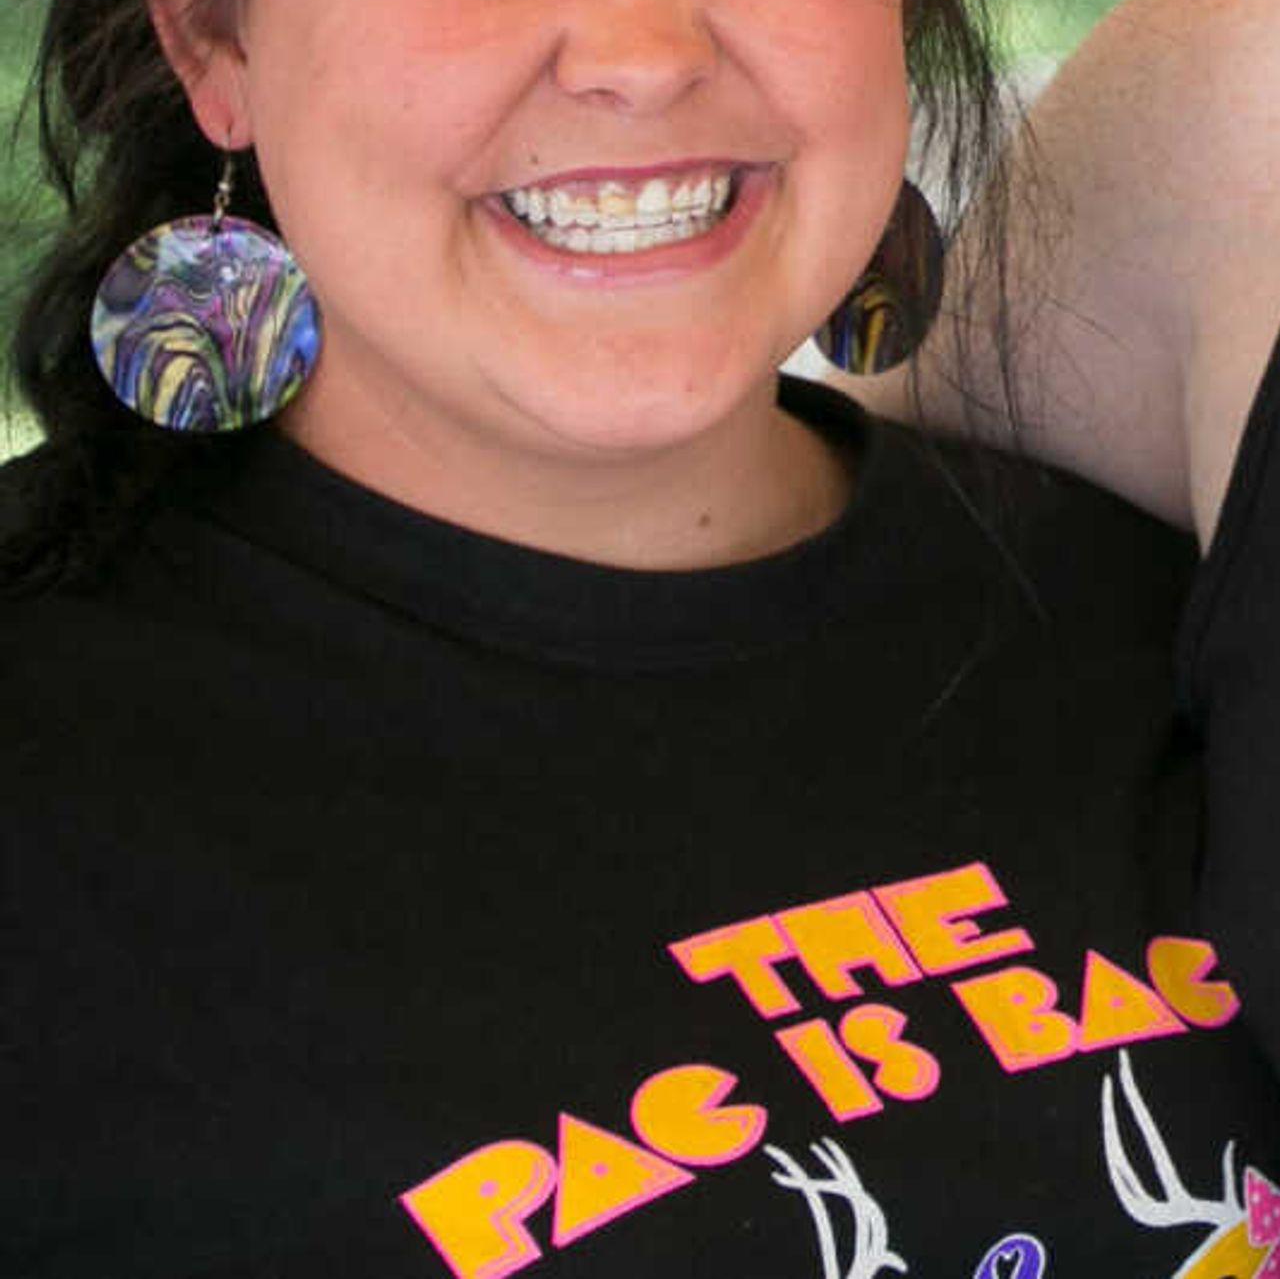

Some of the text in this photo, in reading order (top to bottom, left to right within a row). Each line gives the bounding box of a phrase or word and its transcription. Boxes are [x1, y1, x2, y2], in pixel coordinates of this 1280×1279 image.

[667, 861, 1034, 1020] THE
[398, 1064, 767, 1279] PAC
[774, 1003, 940, 1123] IS
